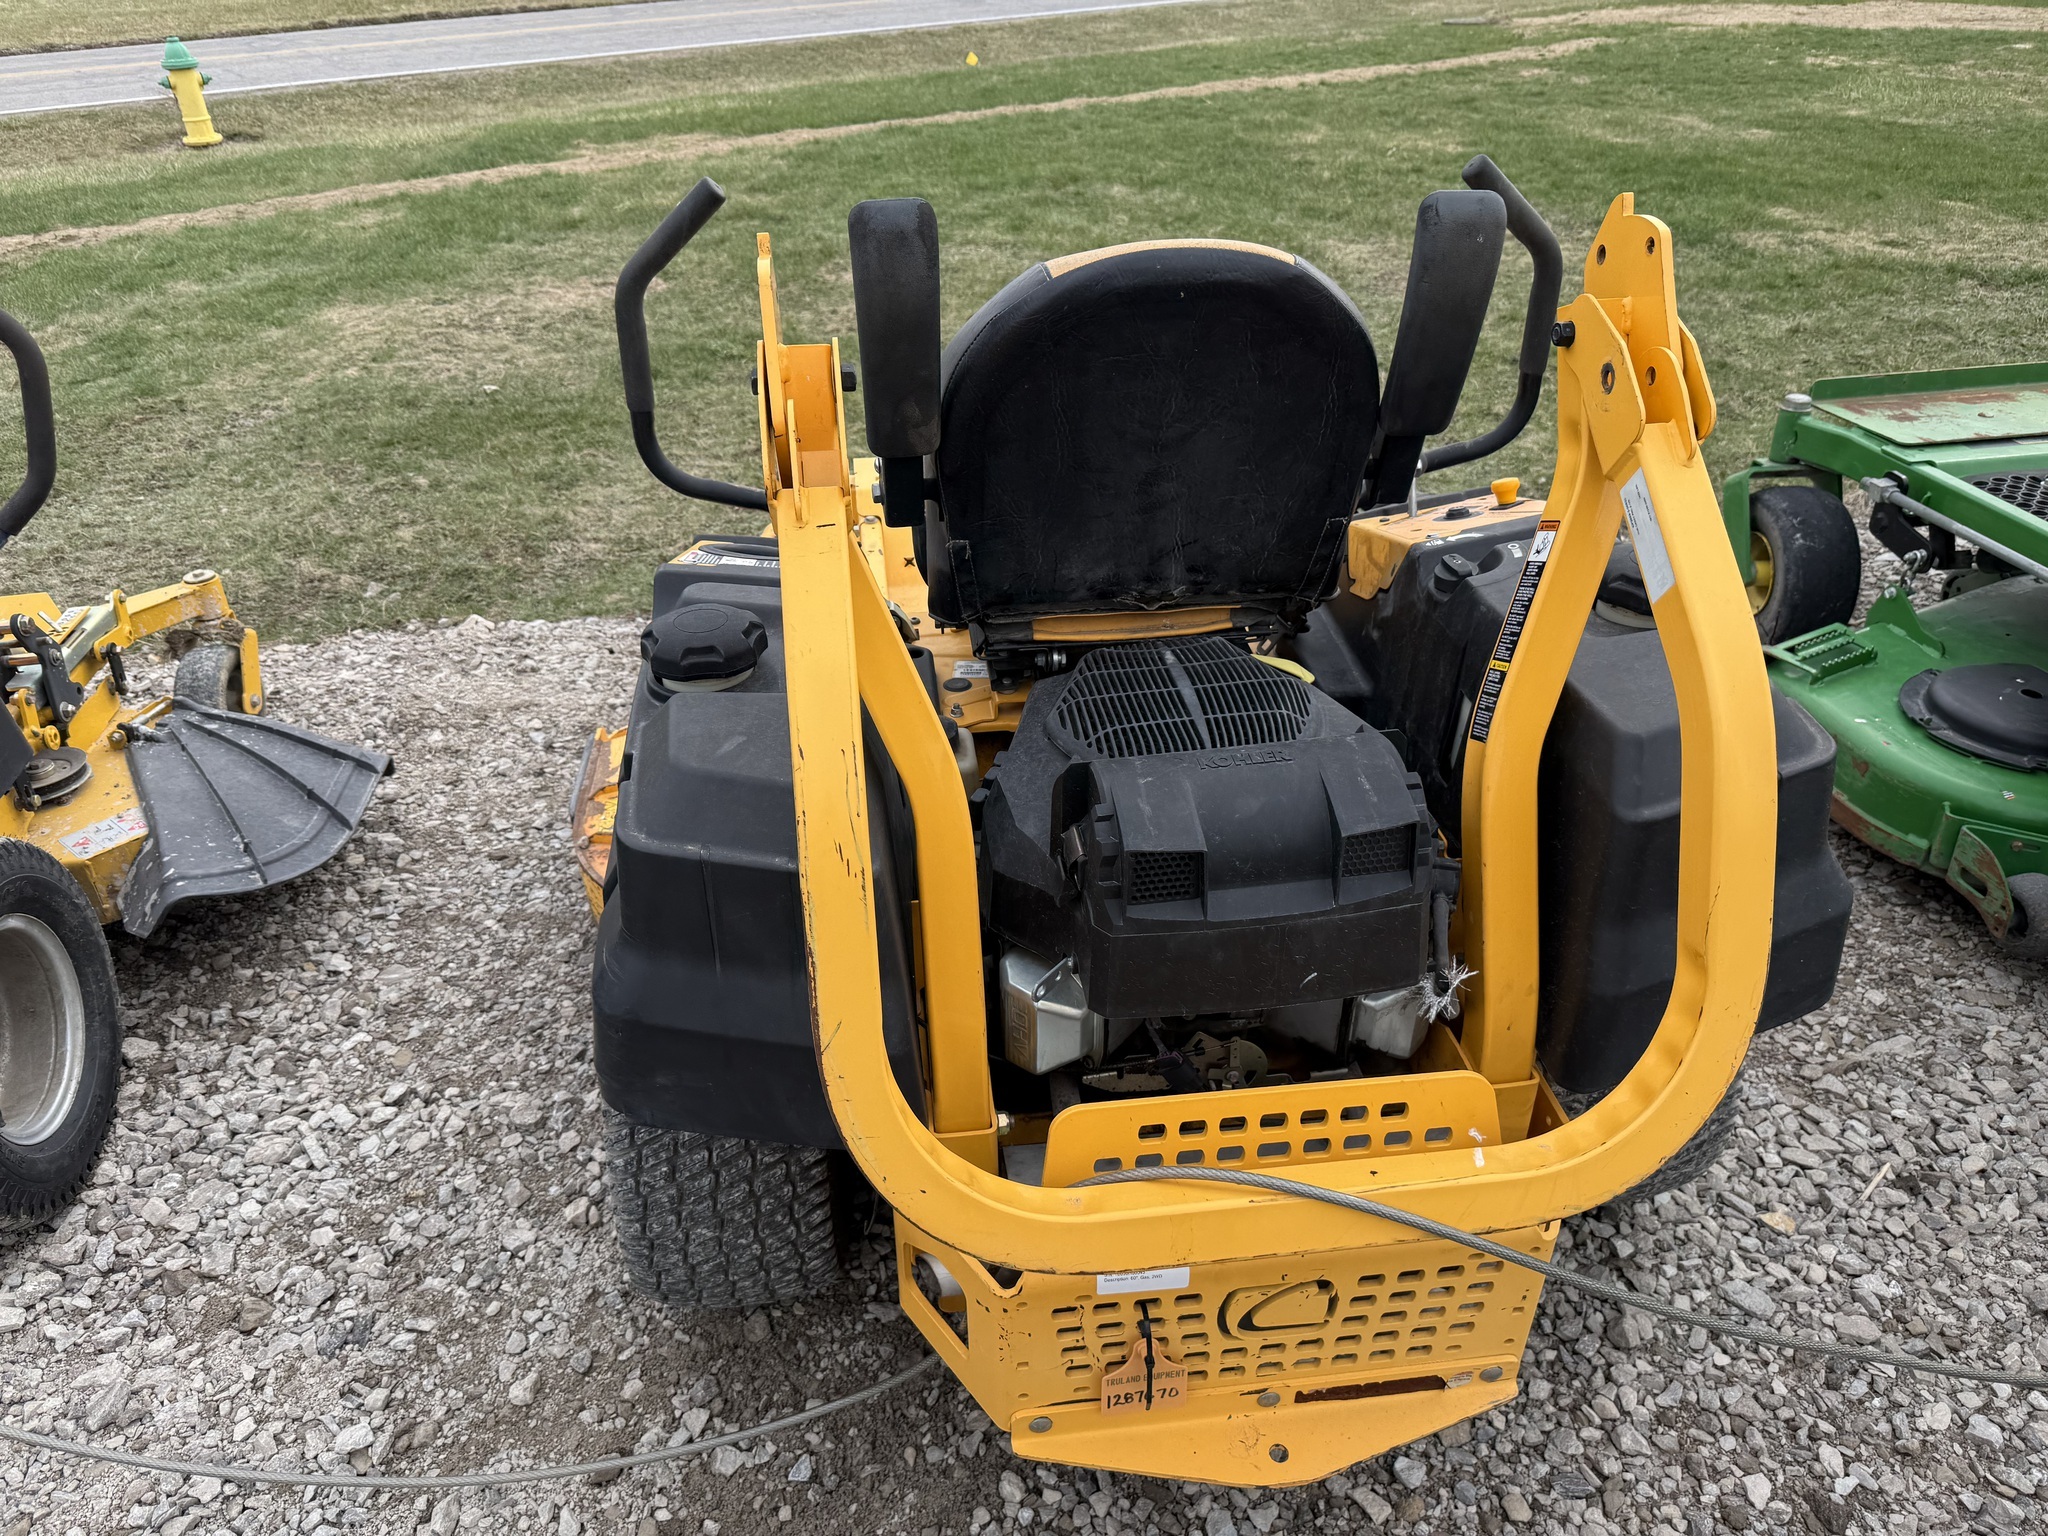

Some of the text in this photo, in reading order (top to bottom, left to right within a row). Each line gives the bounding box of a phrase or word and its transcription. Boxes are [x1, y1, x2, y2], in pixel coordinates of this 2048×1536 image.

[1196, 750, 1293, 770] KOHLER
[1106, 1369, 1186, 1387] TRULAND EUIPMENT
